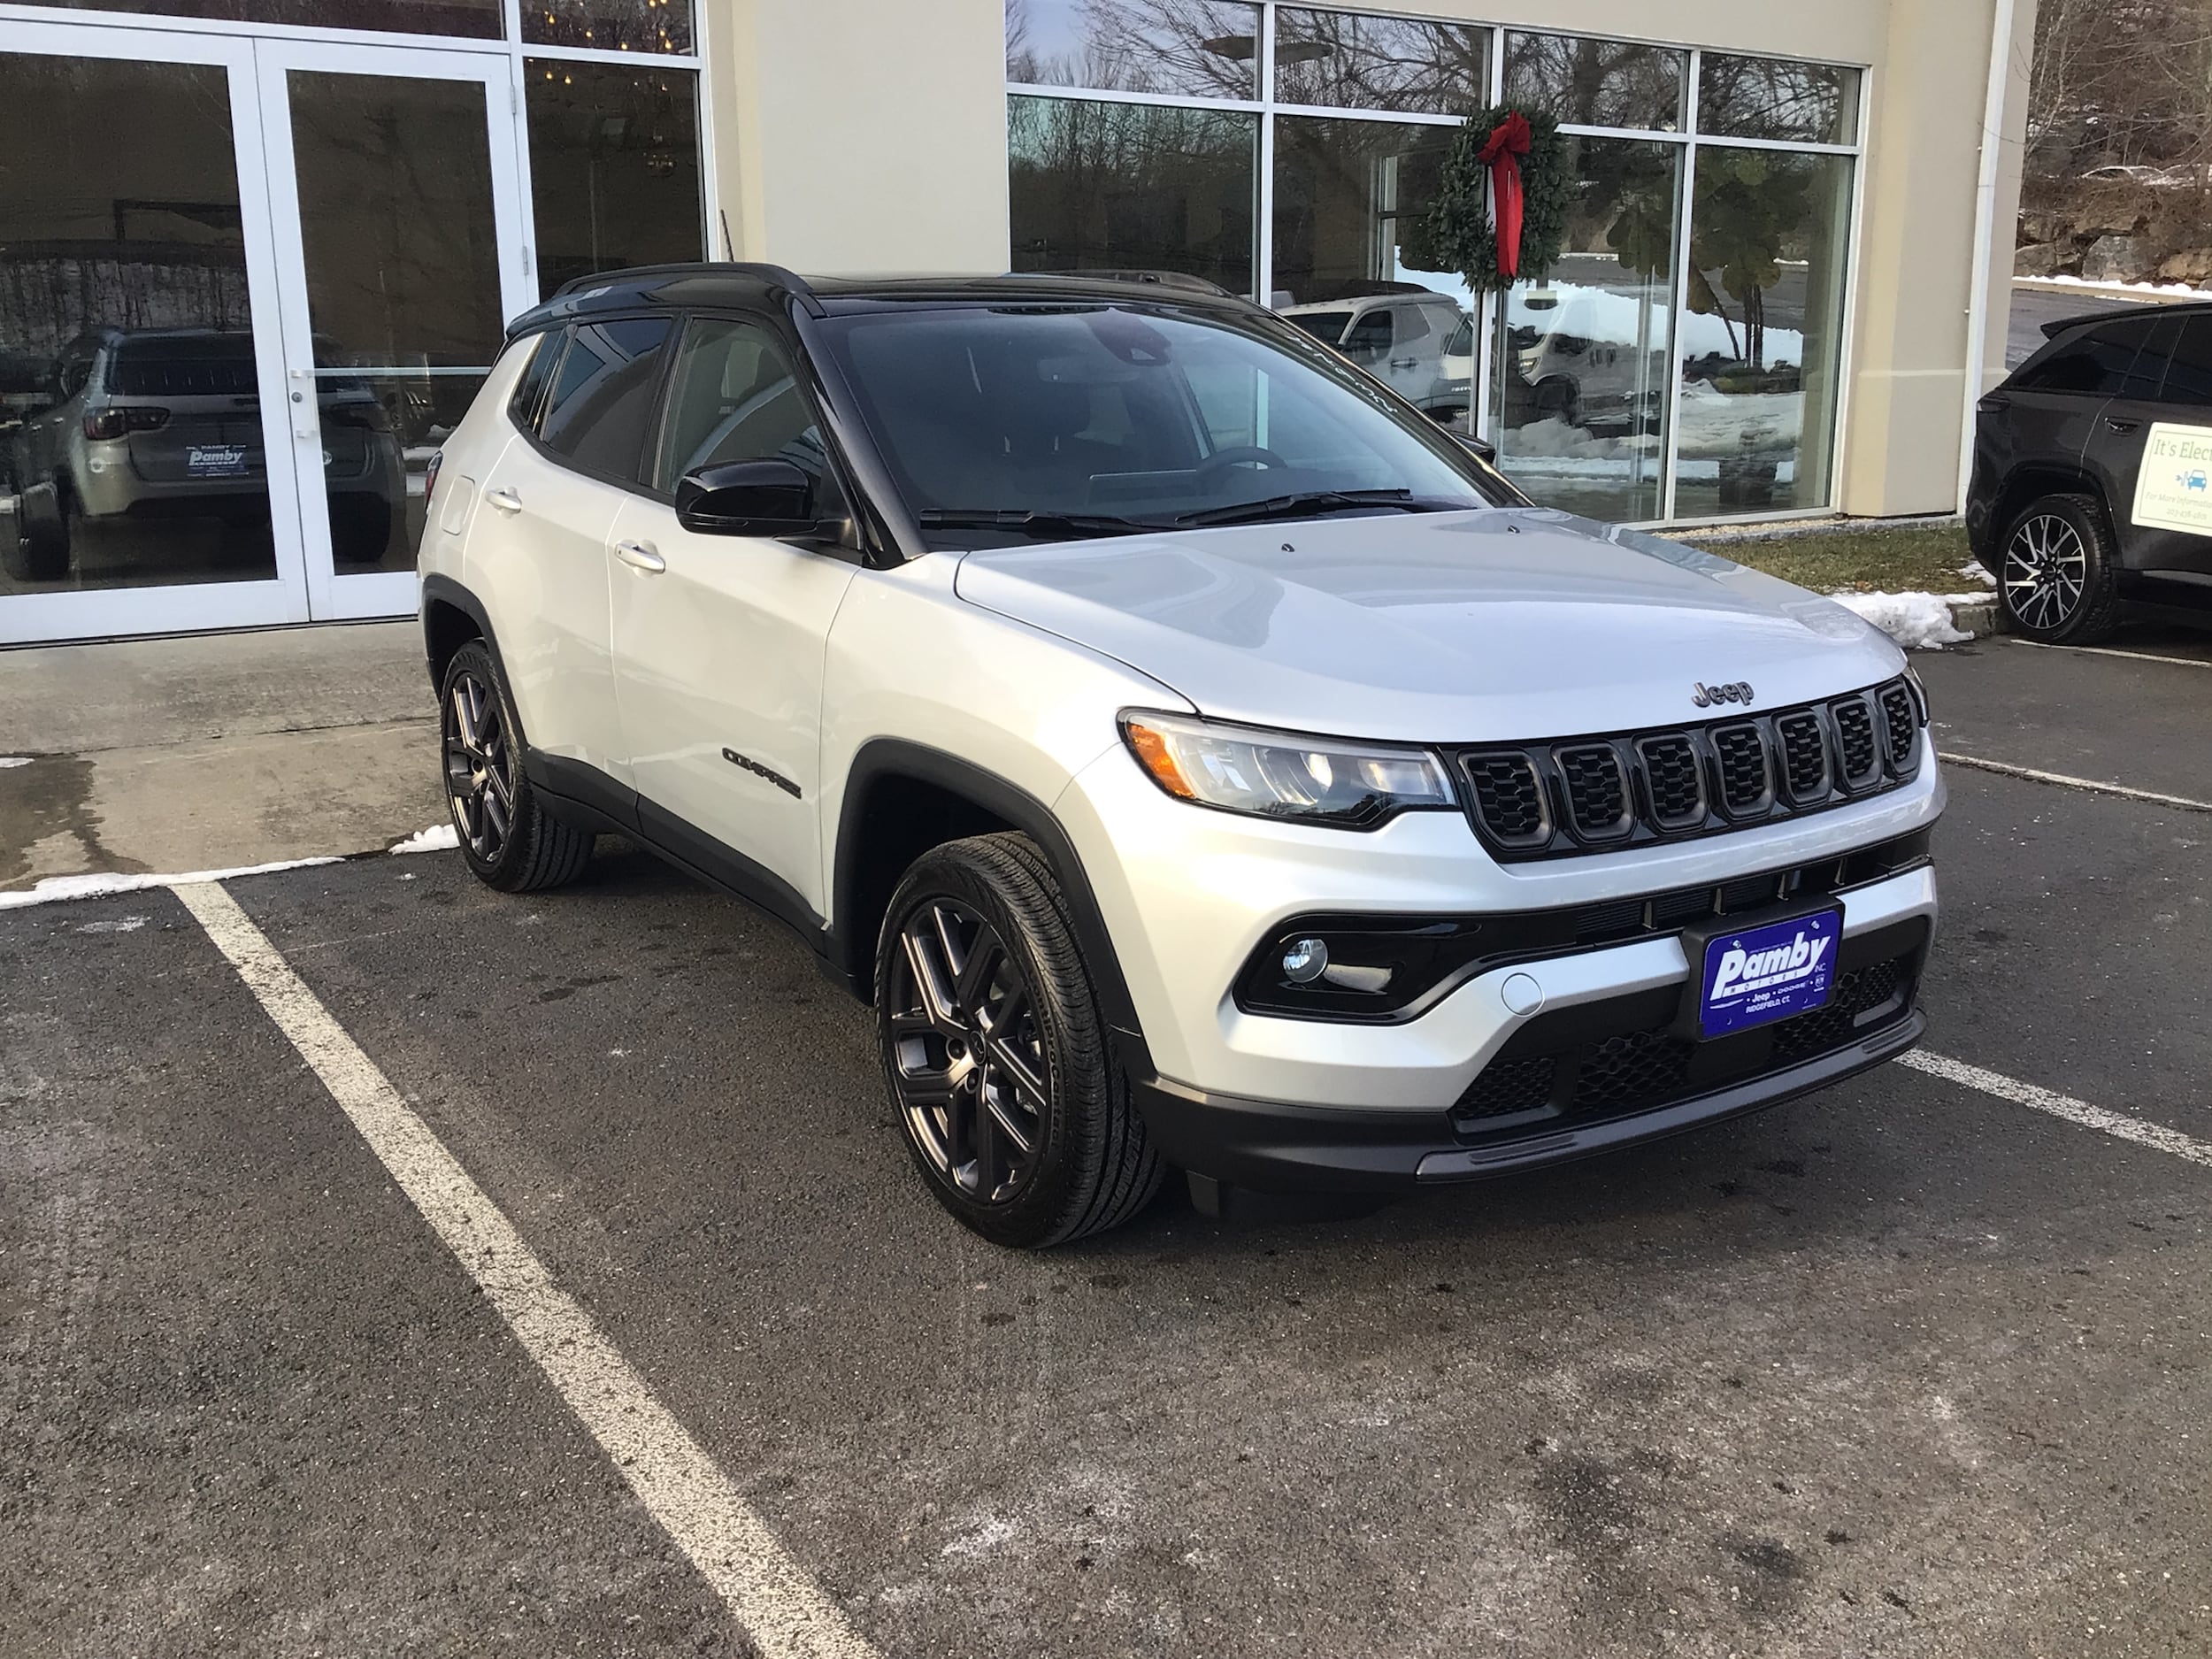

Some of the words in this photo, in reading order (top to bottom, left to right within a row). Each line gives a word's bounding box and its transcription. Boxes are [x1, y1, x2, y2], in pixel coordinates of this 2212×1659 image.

[2154, 439, 2177, 457] It's
[188, 449, 242, 466] Pamby
[2145, 491, 2158, 500] For
[2158, 493, 2176, 503] More
[1691, 681, 1755, 708] Jeep
[1709, 931, 1831, 1001] Pamby
[1752, 992, 1770, 1003] Jeep
